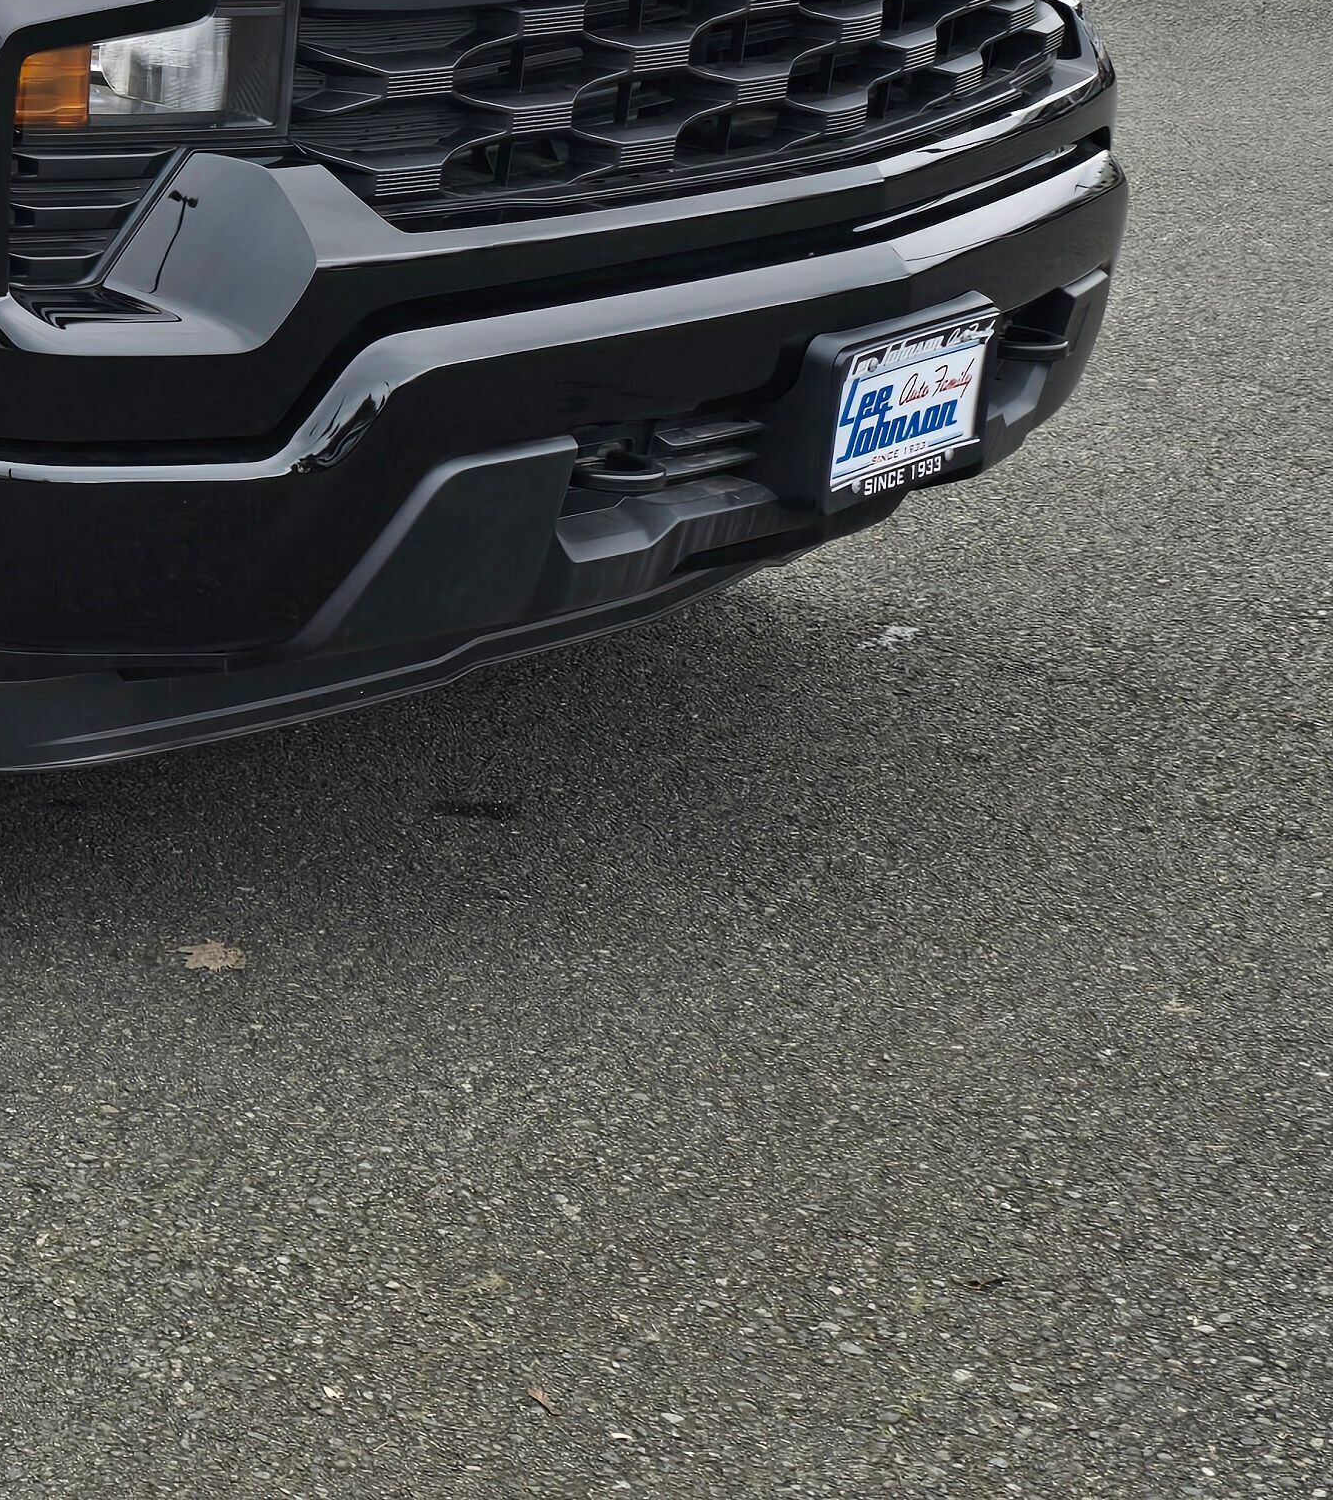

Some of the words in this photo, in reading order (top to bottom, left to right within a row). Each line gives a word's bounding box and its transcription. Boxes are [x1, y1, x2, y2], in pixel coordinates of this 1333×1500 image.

[839, 377, 894, 428] Lee
[898, 372, 929, 406] Auto
[931, 357, 976, 399] Family
[835, 399, 958, 465] Johnson
[863, 468, 906, 496] SINCE
[911, 456, 943, 482] 1933
